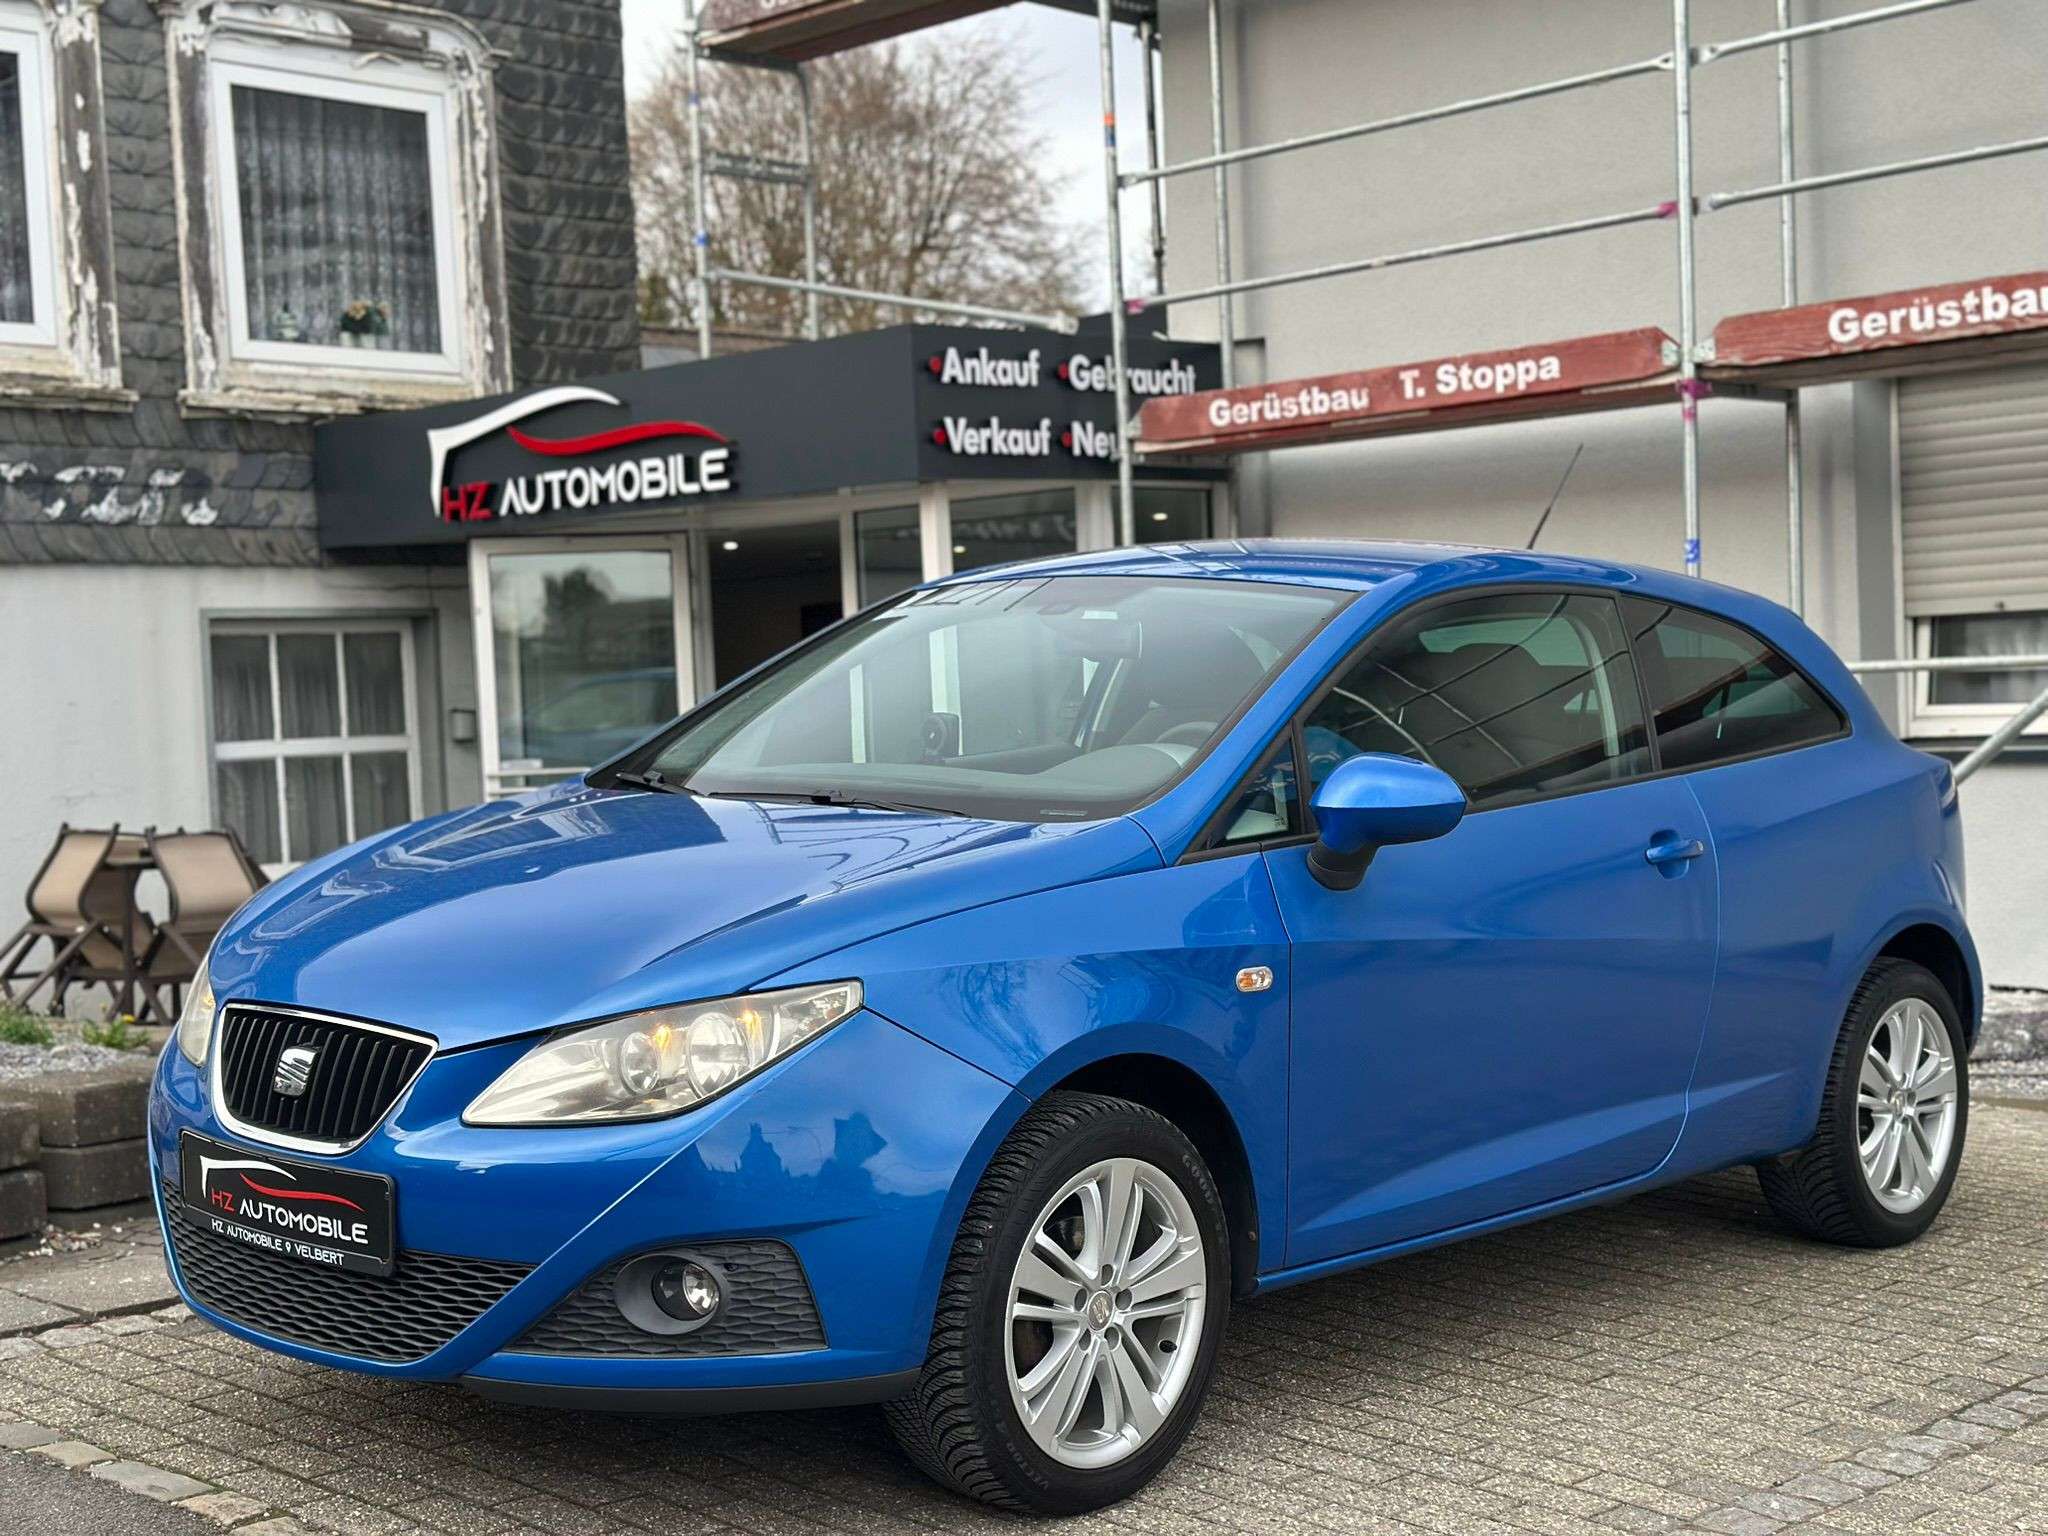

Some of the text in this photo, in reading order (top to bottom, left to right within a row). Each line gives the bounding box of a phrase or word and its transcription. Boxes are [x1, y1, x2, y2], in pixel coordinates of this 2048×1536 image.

[941, 346, 1041, 387] Ankauf
[1208, 355, 1562, 428] Gerüstbau T. Stoppa
[943, 416, 1051, 456] Verkauf
[442, 448, 730, 523] HZ AUTOMOBILE
[211, 1186, 369, 1245] HZ AUTOMOBILE
[211, 1218, 345, 1266] HZ AUTOMOBILE VELBERT
